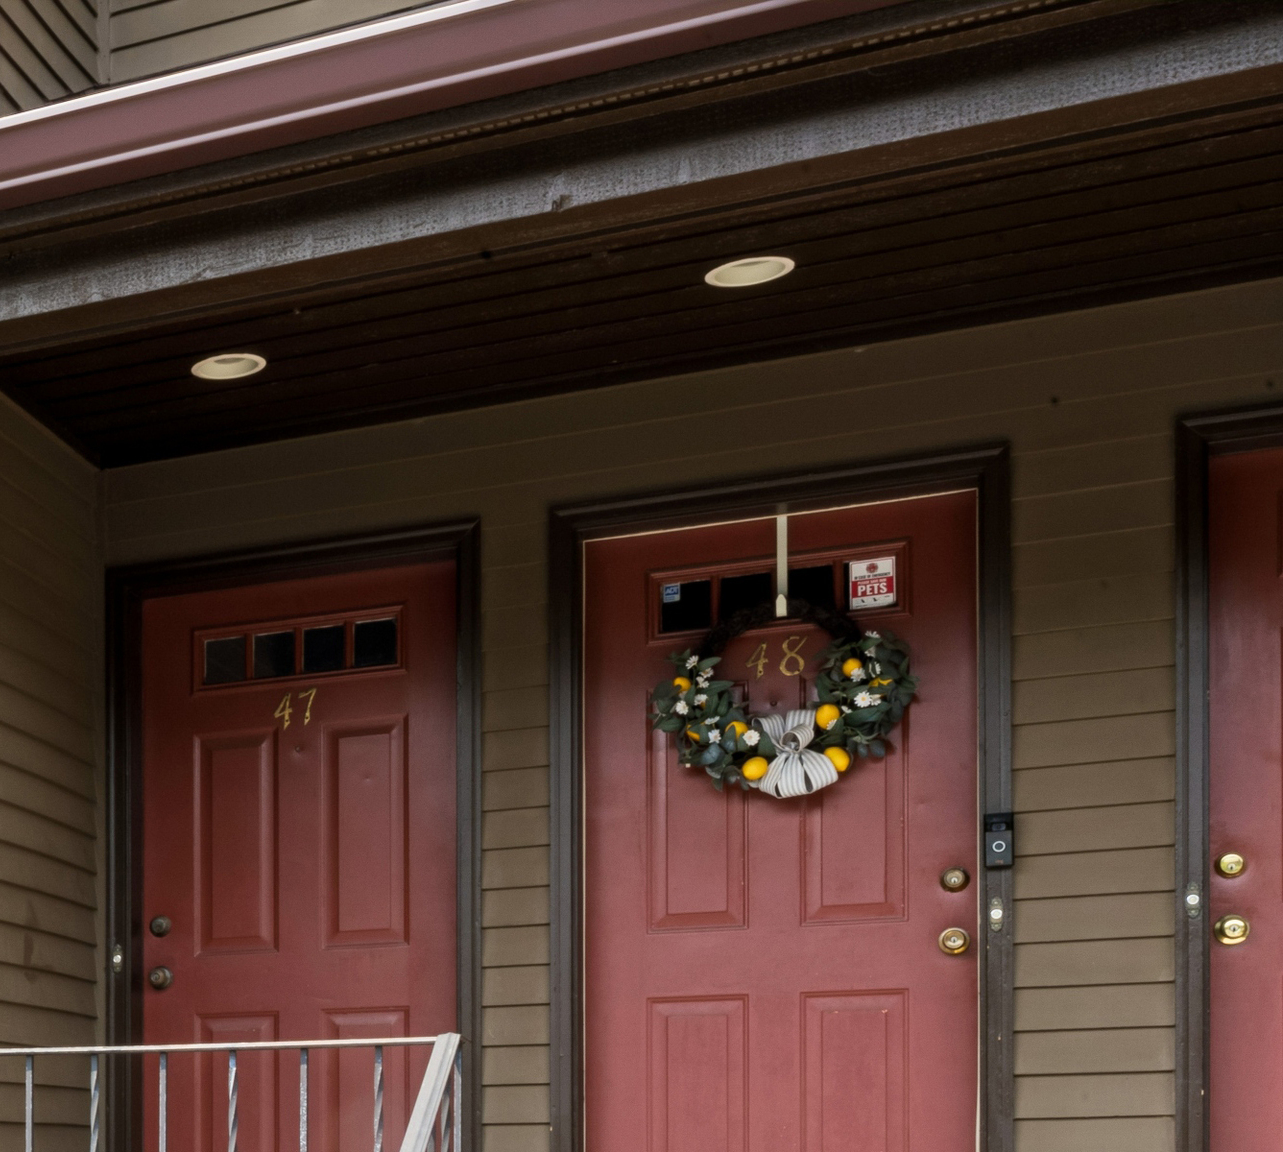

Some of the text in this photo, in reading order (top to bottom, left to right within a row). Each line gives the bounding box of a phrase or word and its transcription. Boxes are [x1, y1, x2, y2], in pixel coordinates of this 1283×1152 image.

[857, 582, 888, 596] PETS
[746, 636, 807, 680] 48
[274, 688, 317, 730] 47
